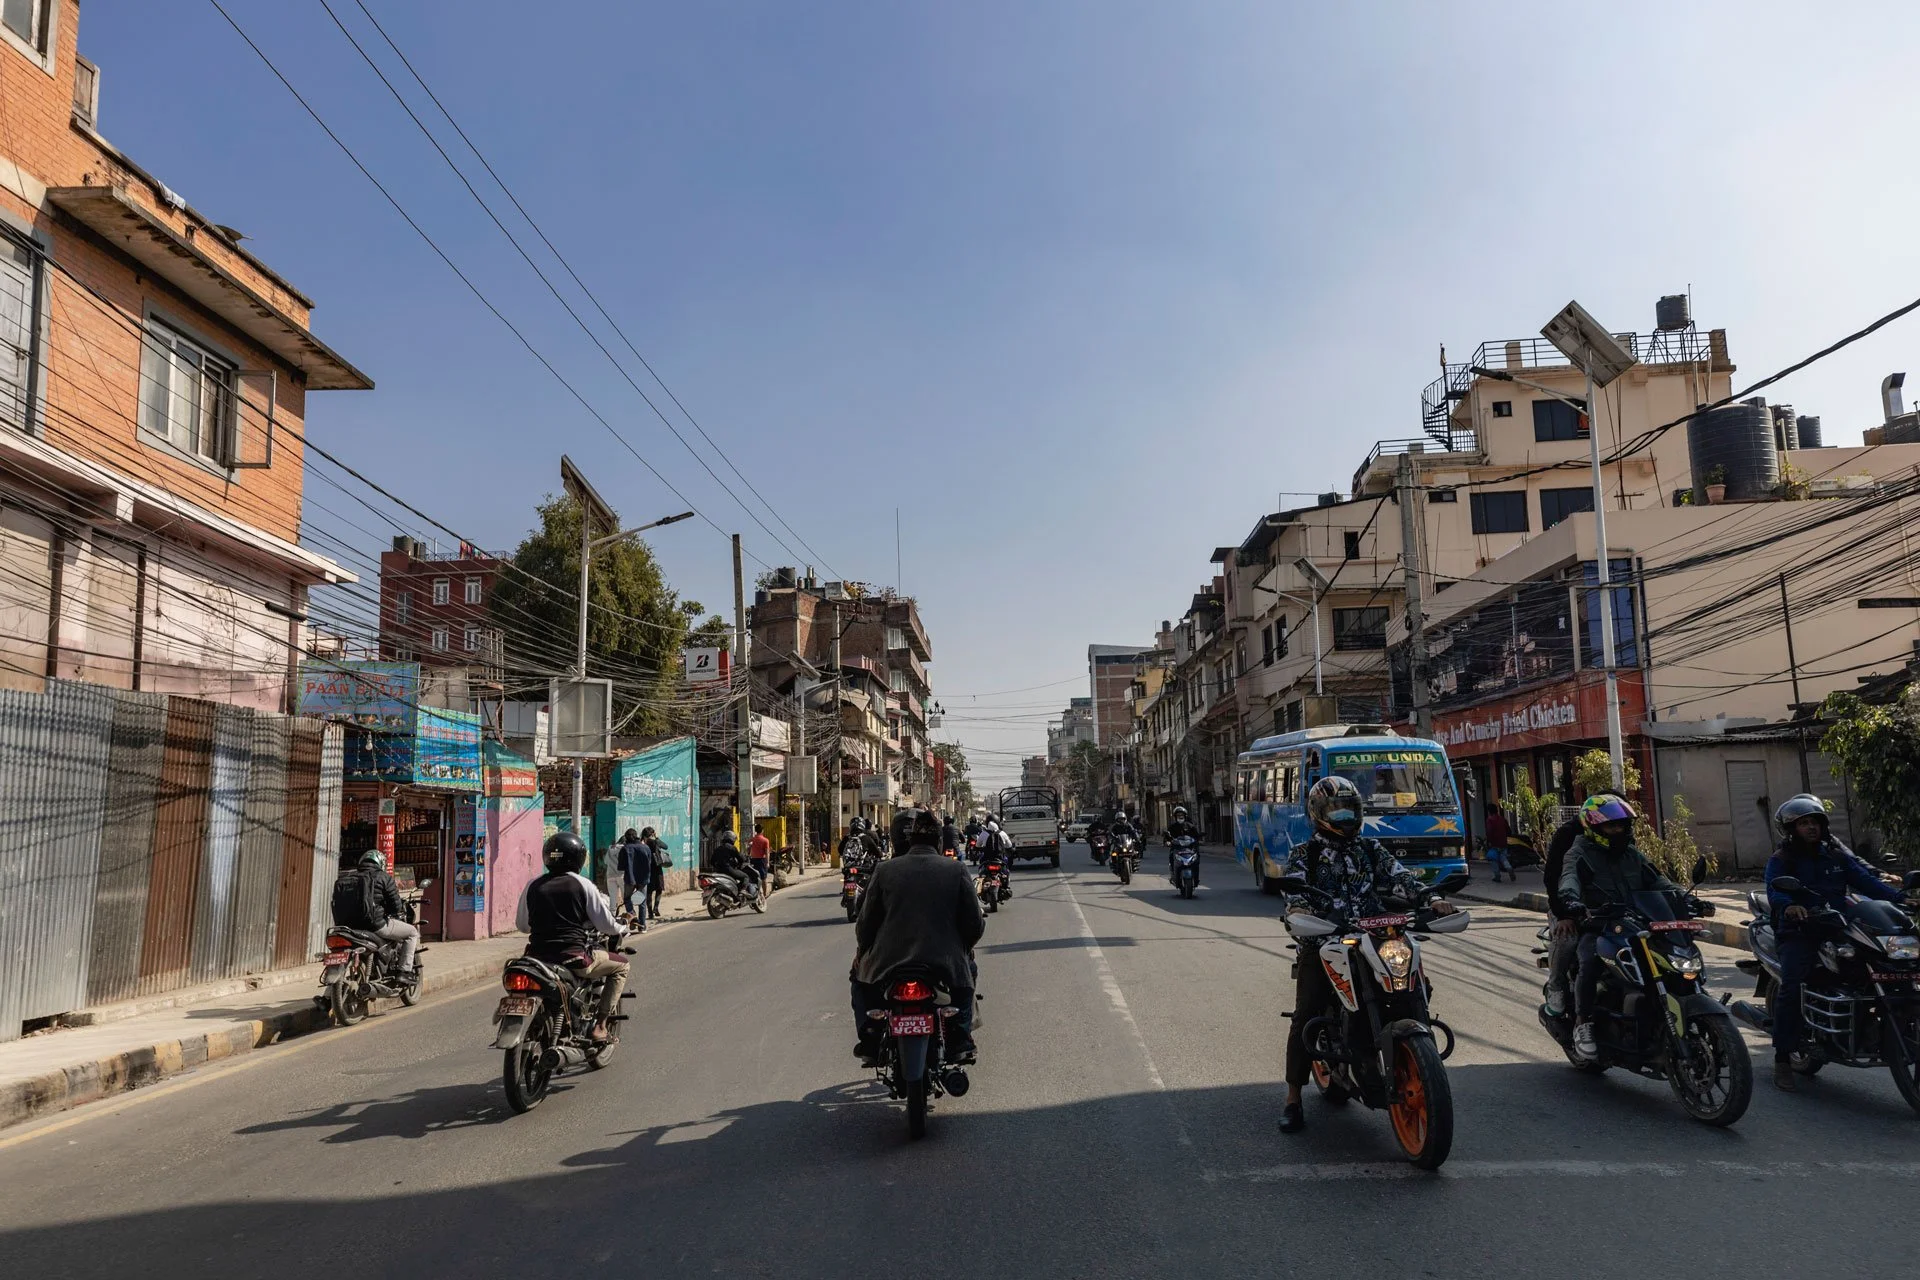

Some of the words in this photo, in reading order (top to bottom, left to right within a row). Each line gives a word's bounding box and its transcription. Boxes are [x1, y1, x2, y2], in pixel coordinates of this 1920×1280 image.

[306, 682, 350, 695] PAAN
[1450, 722, 1465, 745] And
[1466, 716, 1501, 742] Crunchy
[1502, 709, 1530, 736] Fried
[1530, 700, 1577, 730] Chicken
[1335, 753, 1437, 764] BADMUNDA
